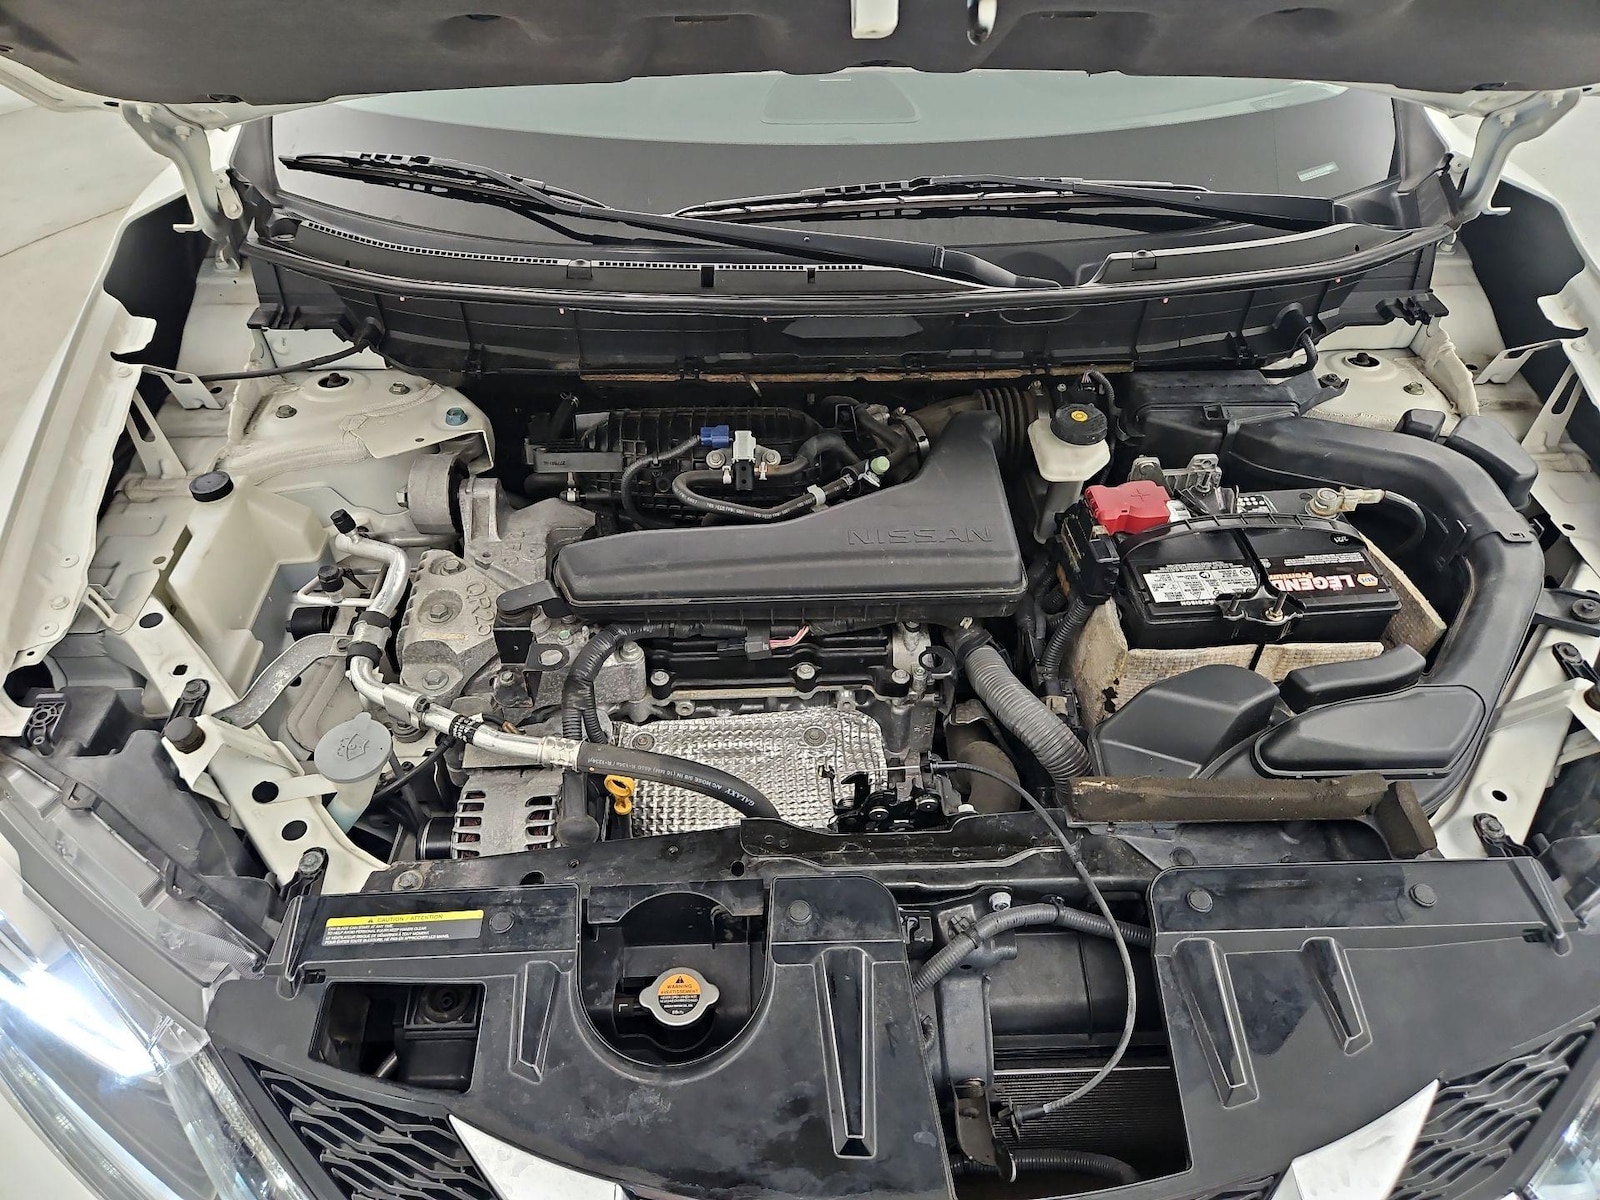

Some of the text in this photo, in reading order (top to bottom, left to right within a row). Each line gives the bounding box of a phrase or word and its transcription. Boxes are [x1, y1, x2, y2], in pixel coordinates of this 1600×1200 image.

[848, 528, 992, 545] NISSAN
[1270, 574, 1355, 592] LEGEND
[695, 775, 711, 786] HOSE
[725, 788, 755, 807] GALAXY
